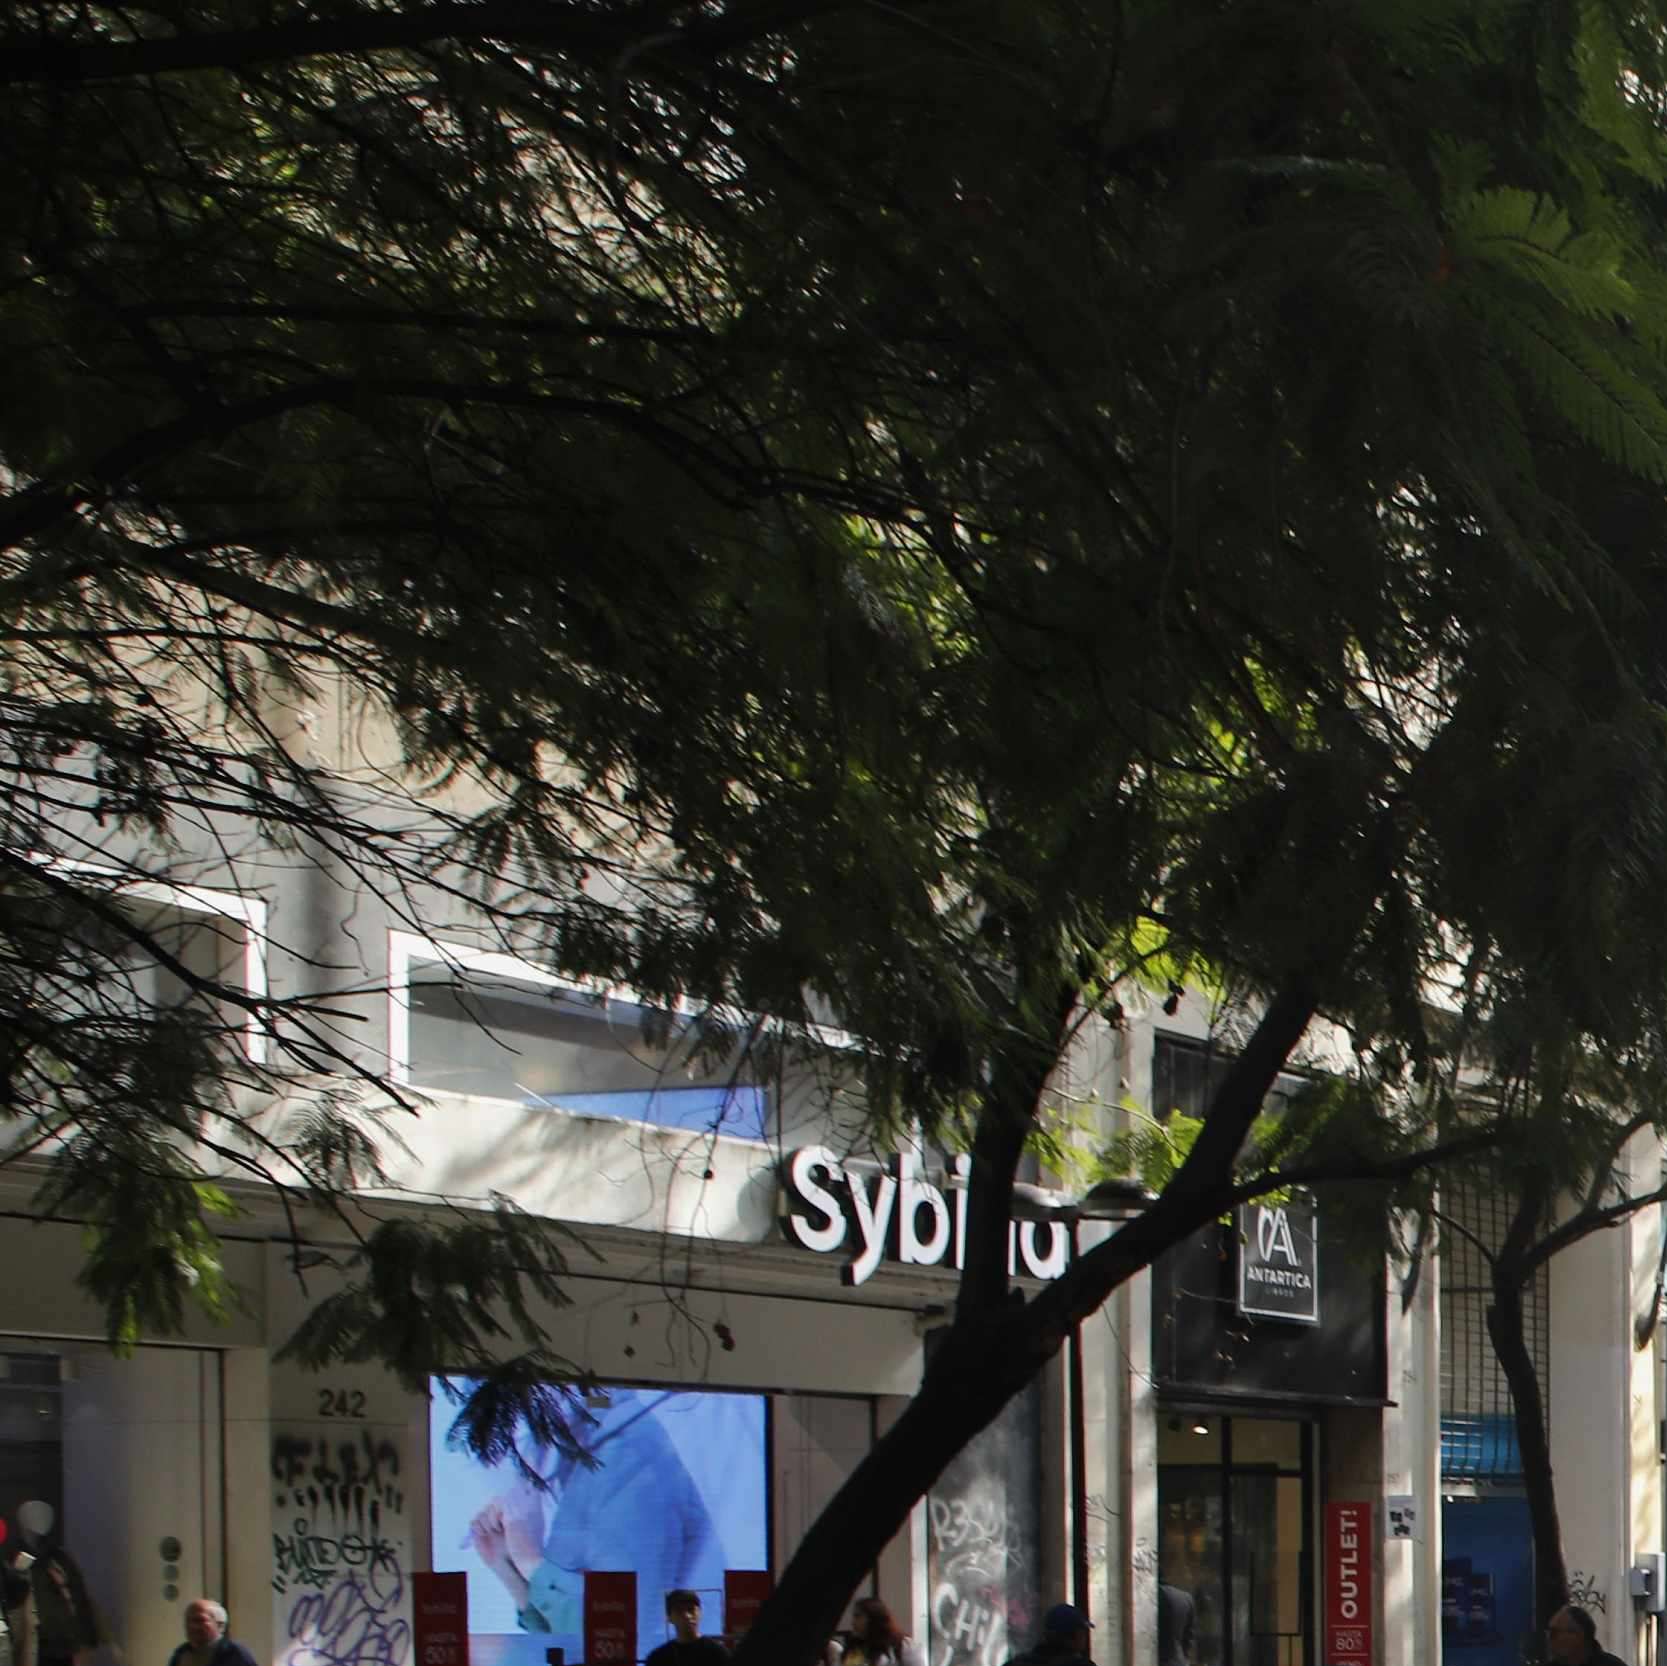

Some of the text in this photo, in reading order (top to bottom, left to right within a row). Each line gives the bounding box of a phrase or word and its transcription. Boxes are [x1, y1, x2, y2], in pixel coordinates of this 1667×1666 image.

[790, 1145, 1071, 1285] Sybia
[1247, 1264, 1312, 1289] ANTARTICA
[318, 1387, 367, 1419] 242
[1340, 1509, 1358, 1620] OUTLET!
